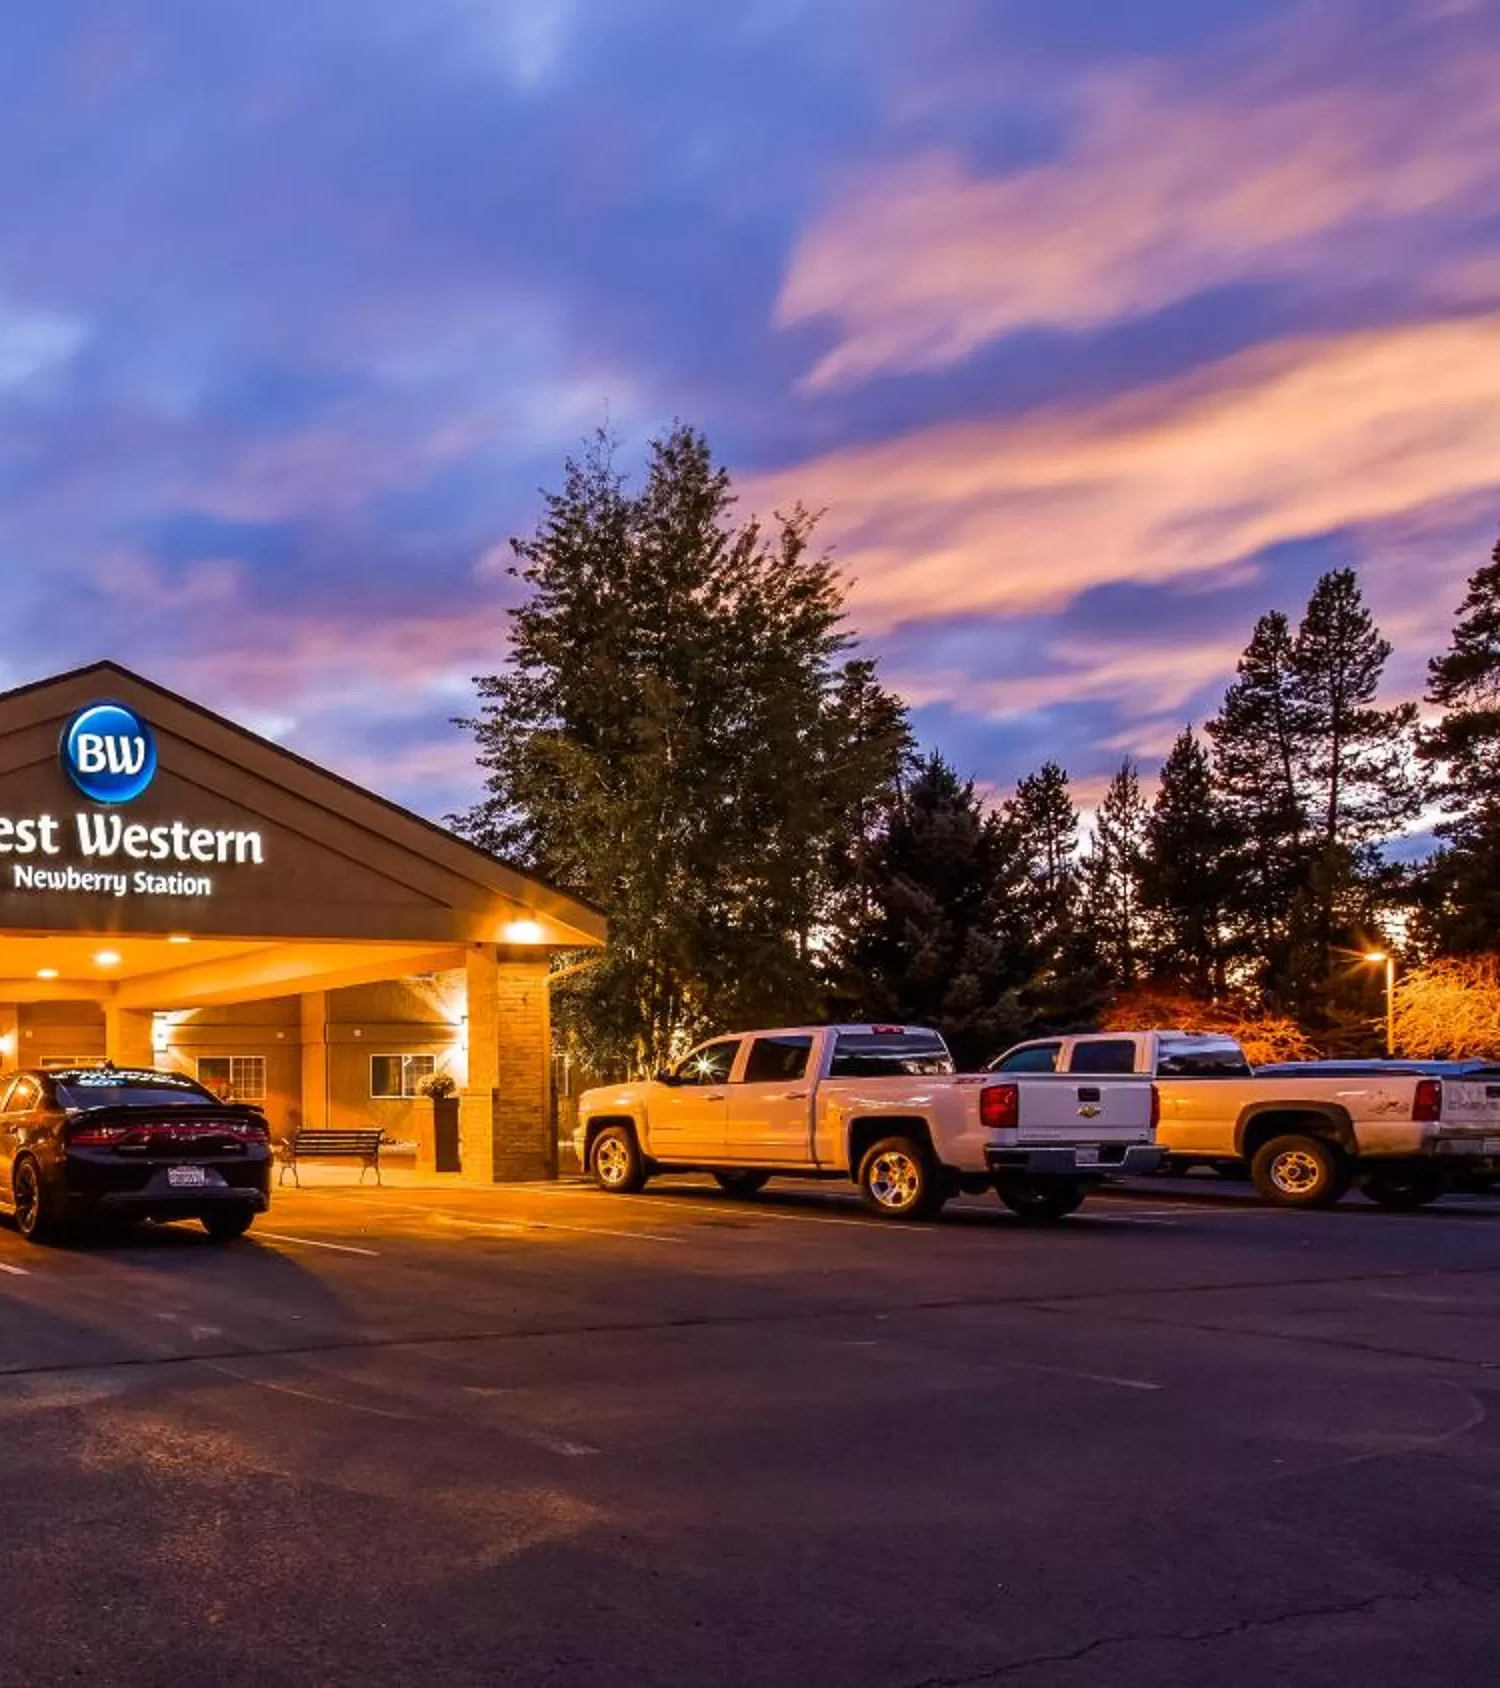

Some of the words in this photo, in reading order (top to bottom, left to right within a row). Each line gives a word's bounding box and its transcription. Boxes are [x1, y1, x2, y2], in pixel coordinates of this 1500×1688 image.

[77, 733, 145, 776] BW
[75, 813, 264, 864] Western
[13, 865, 127, 897] Newberry
[133, 871, 212, 896] Station
